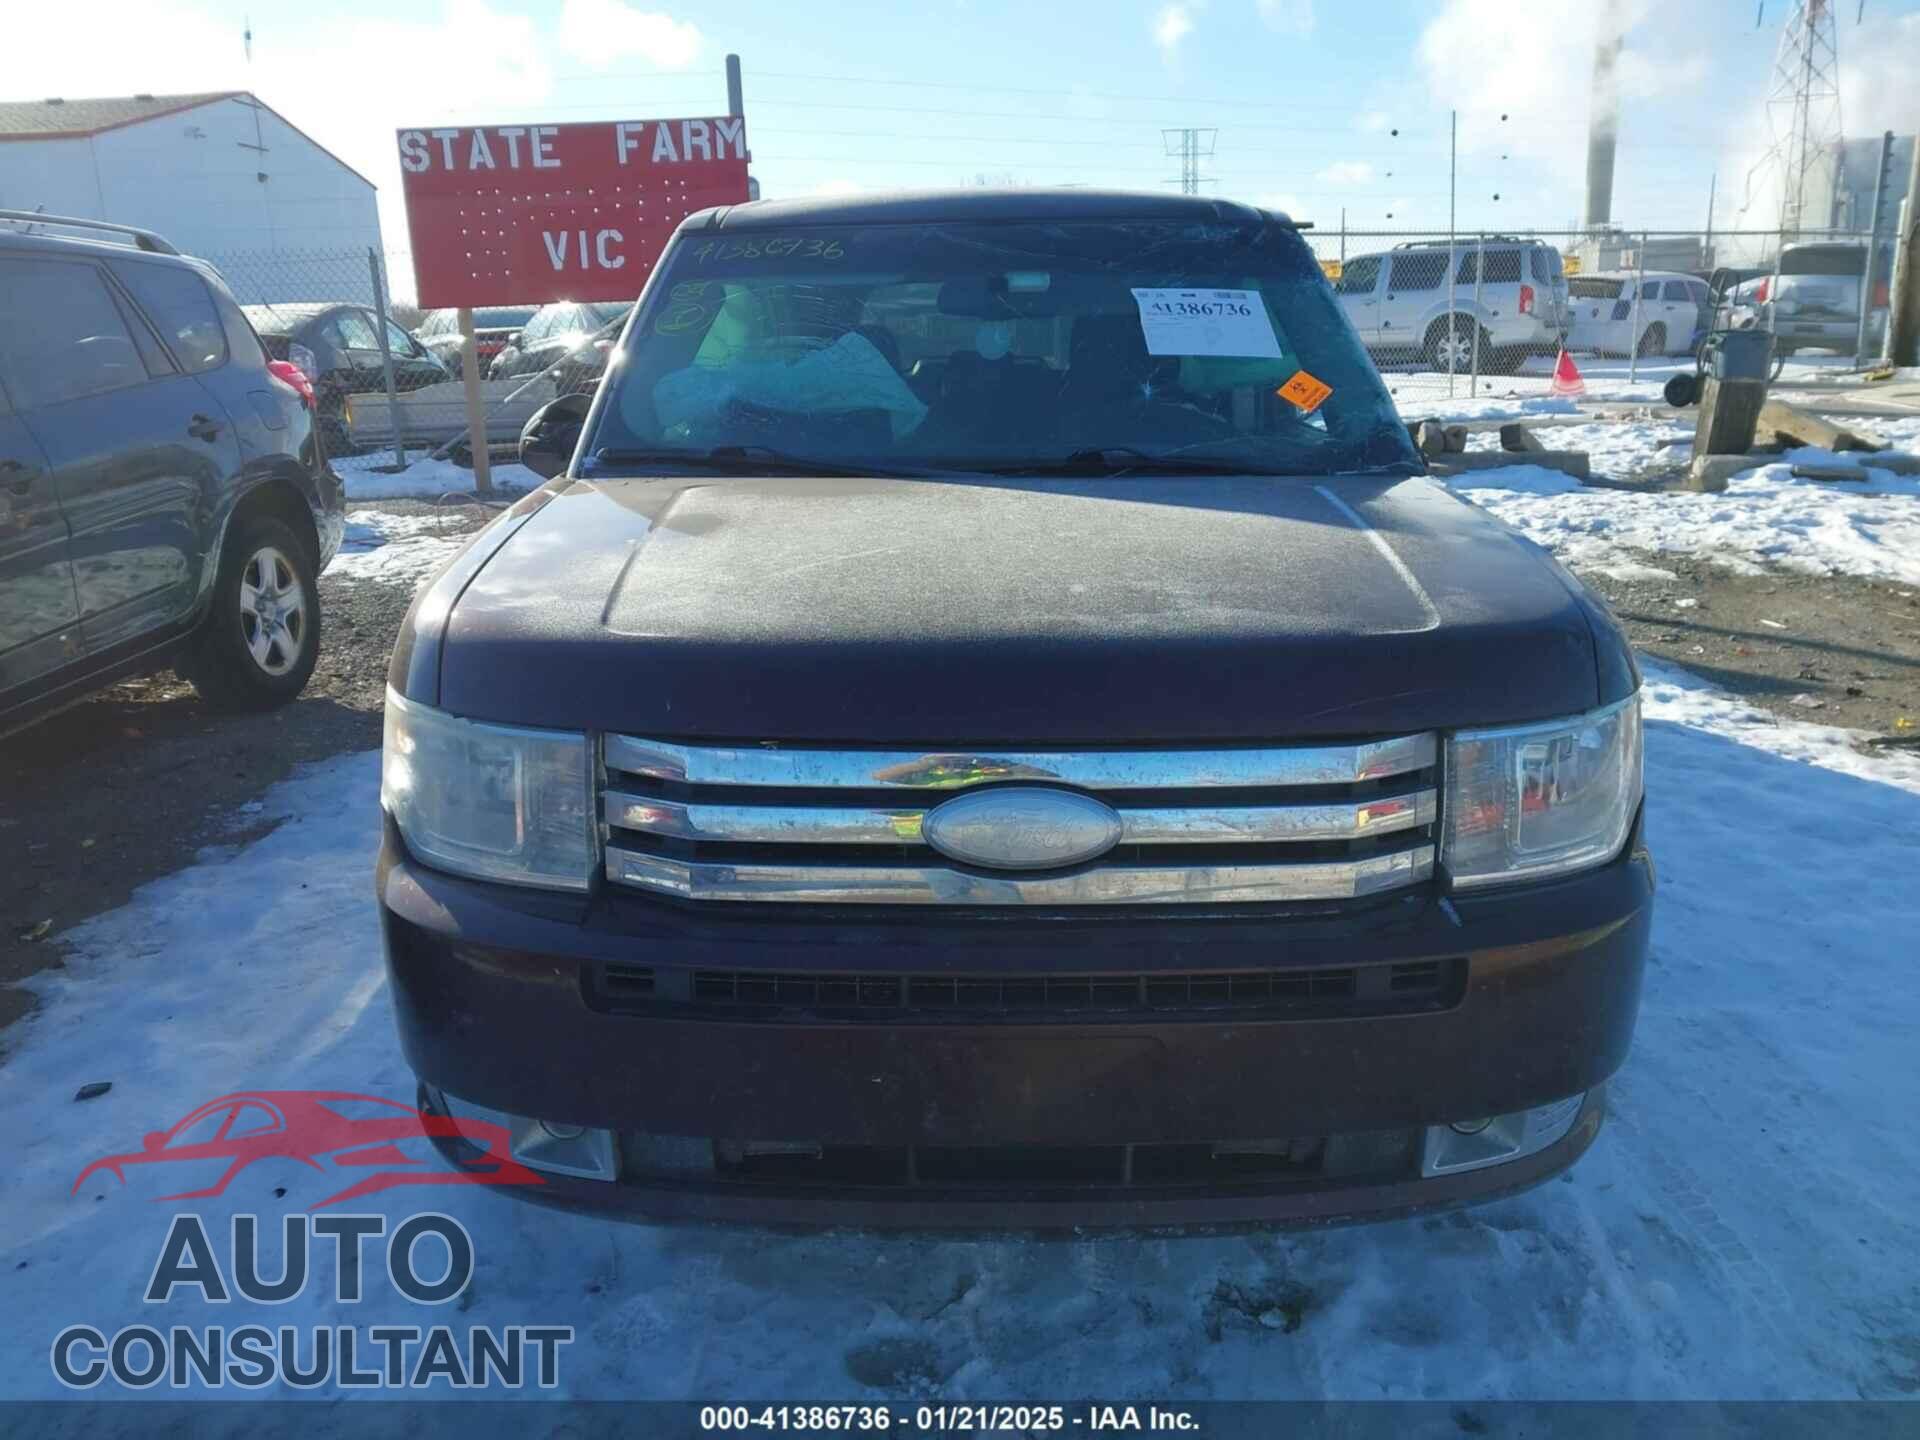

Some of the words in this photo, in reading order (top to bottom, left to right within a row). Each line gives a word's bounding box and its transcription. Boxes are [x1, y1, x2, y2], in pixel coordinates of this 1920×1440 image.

[400, 126, 561, 173] STATE
[616, 117, 746, 165] FARM
[542, 229, 625, 271] VIC
